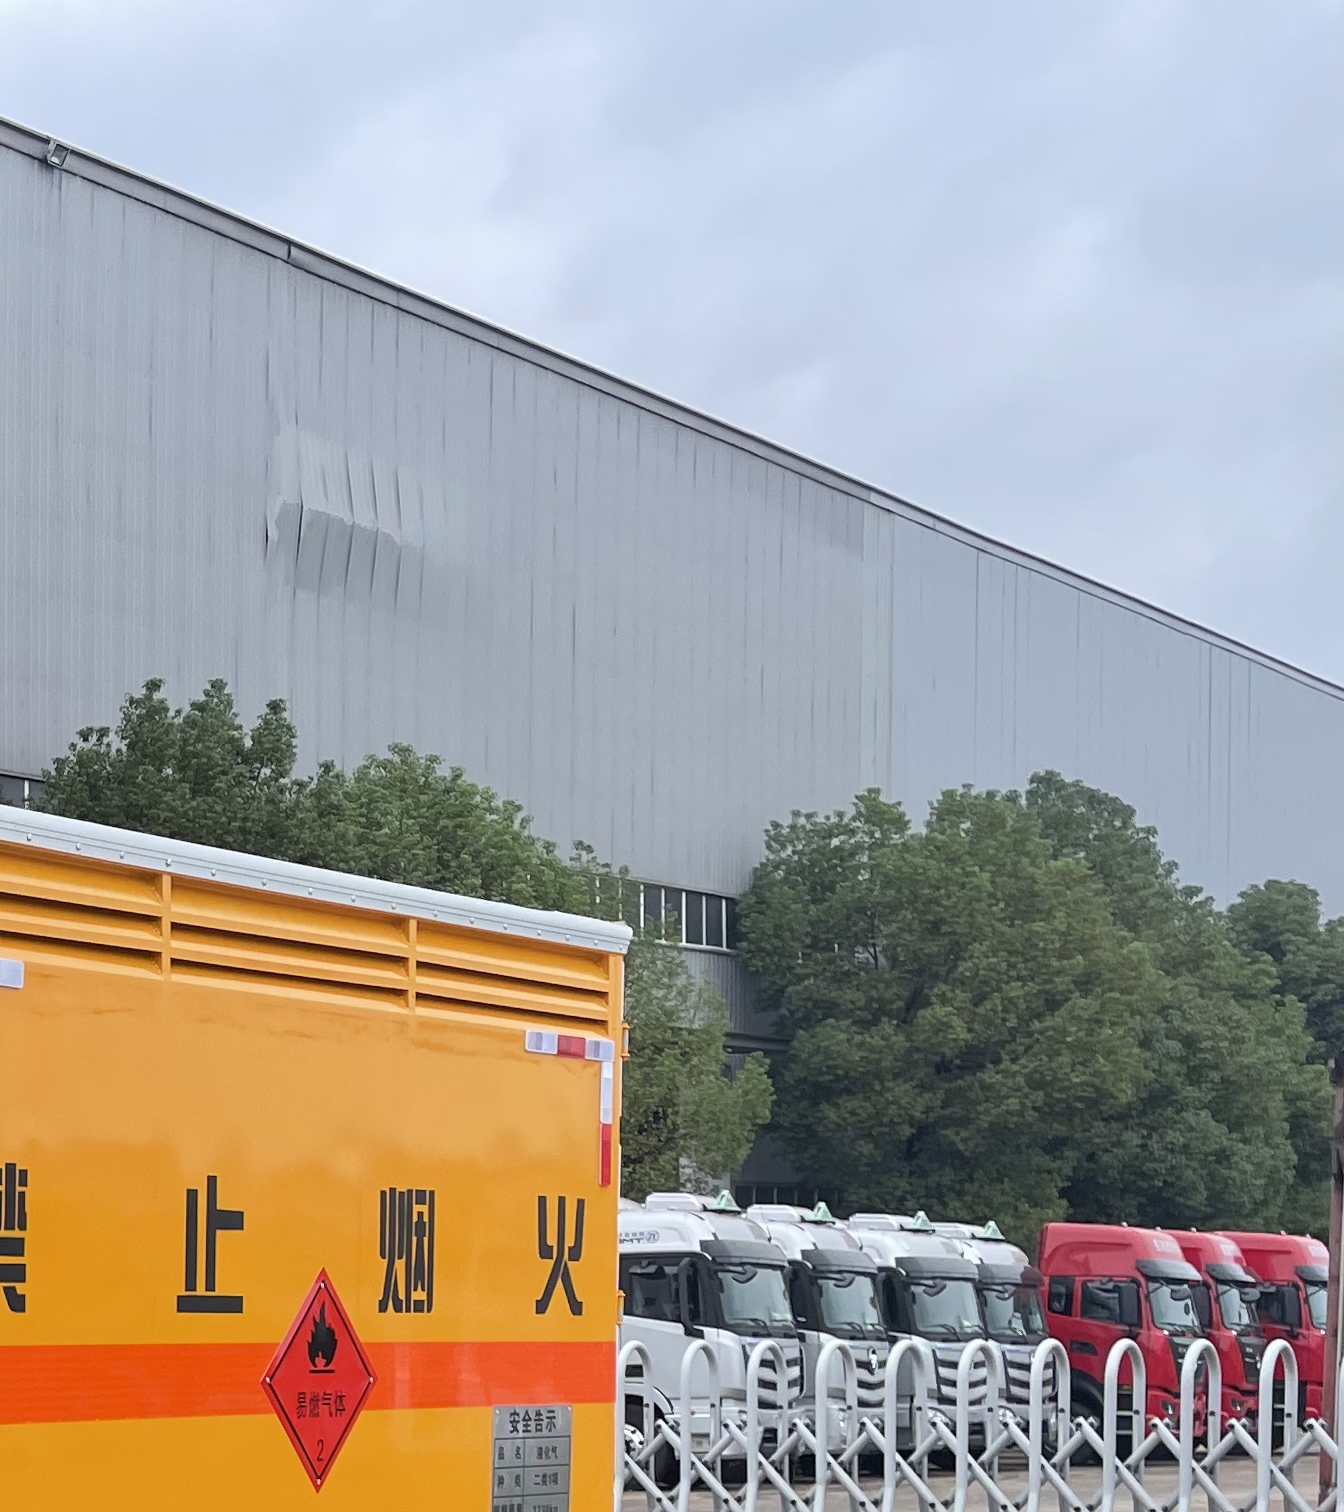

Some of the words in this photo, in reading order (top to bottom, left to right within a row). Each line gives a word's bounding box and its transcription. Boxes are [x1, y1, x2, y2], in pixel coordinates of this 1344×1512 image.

[296, 1390, 346, 1419] 易燃气体
[509, 1409, 557, 1434] 安全告示
[316, 1438, 325, 1462] 2
